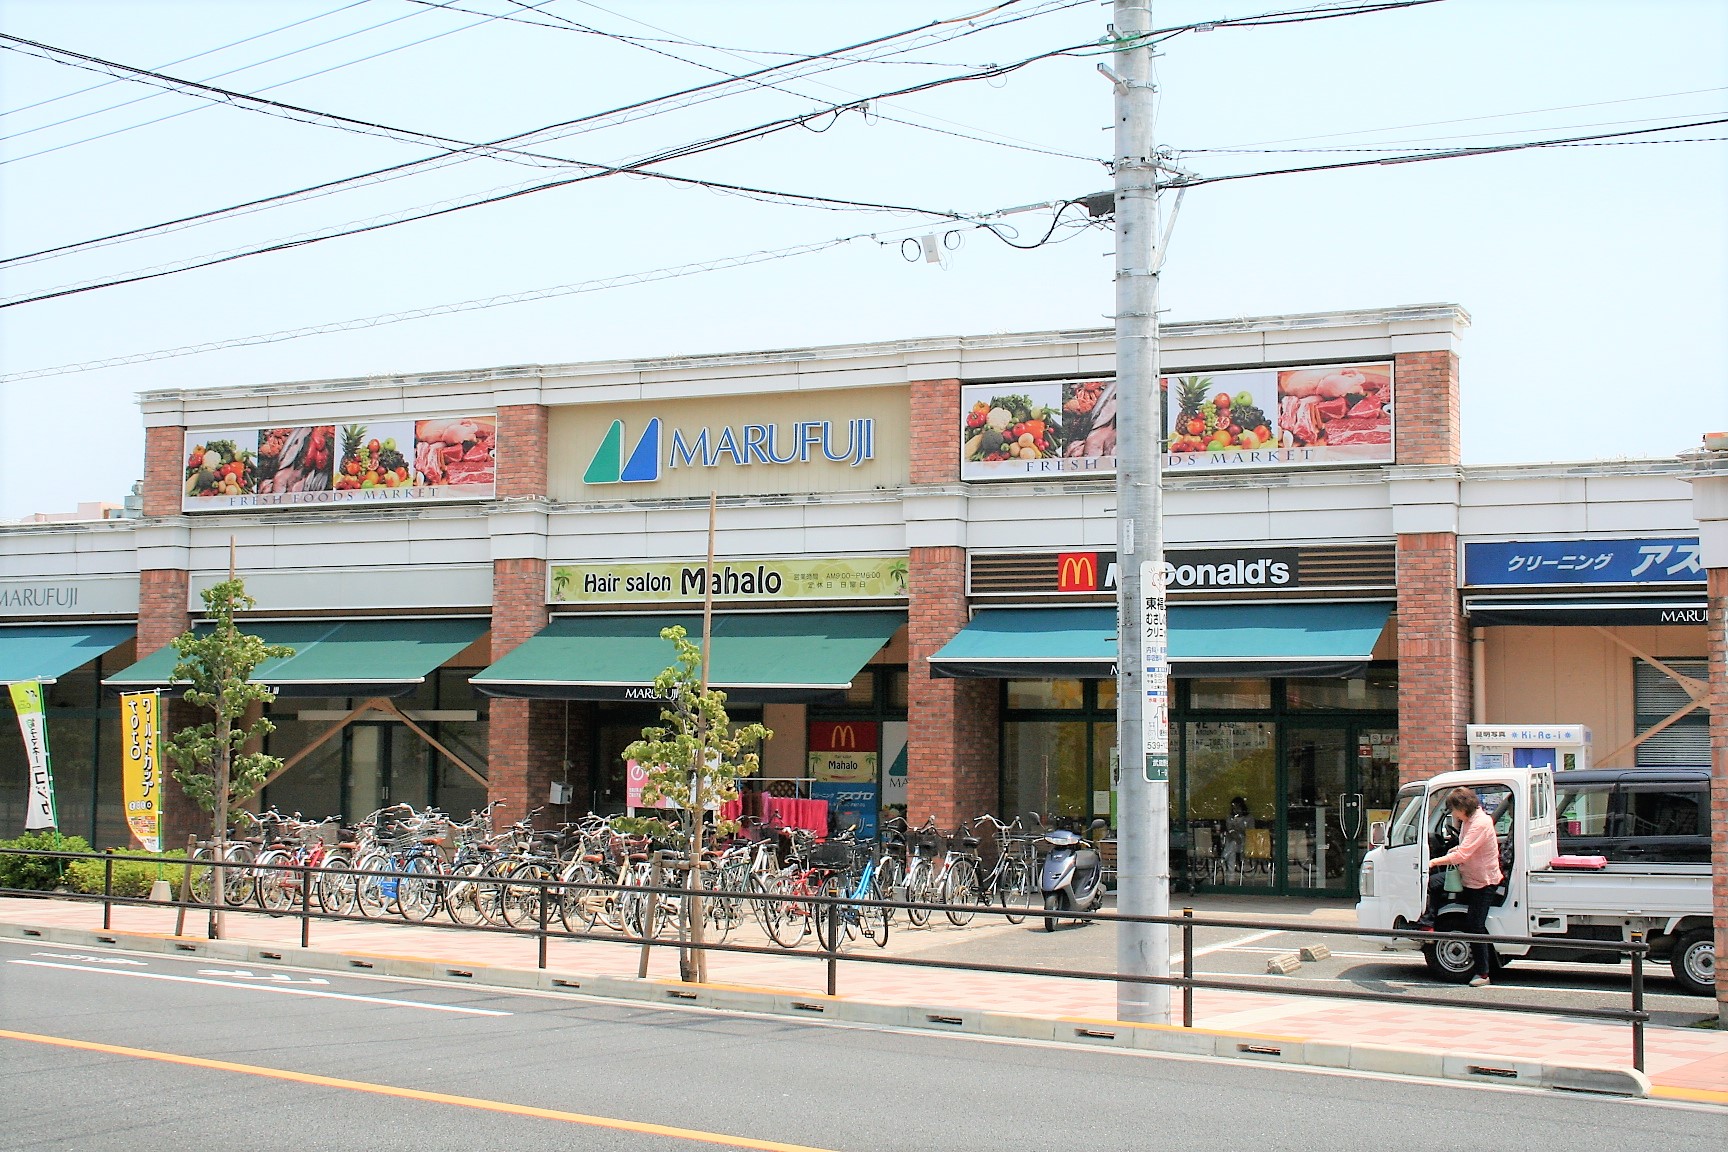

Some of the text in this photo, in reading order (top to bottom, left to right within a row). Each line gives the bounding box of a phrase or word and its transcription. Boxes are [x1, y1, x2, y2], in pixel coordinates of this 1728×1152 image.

[669, 418, 876, 468] MARUFUJI
[1026, 459, 1097, 472] FRESH
[1210, 449, 1313, 464] MARKET
[230, 487, 439, 506] FRESH FOODS MARKET
[1104, 559, 1290, 587] onald's
[1508, 553, 1614, 572] クリーニング
[584, 565, 782, 595] Hair salon Mahalo
[1145, 596, 1166, 610] 東福
[625, 687, 679, 701] MARUUJI
[128, 700, 142, 760] toto
[142, 698, 154, 797] ワールドカップ
[828, 760, 858, 770] Mahalo
